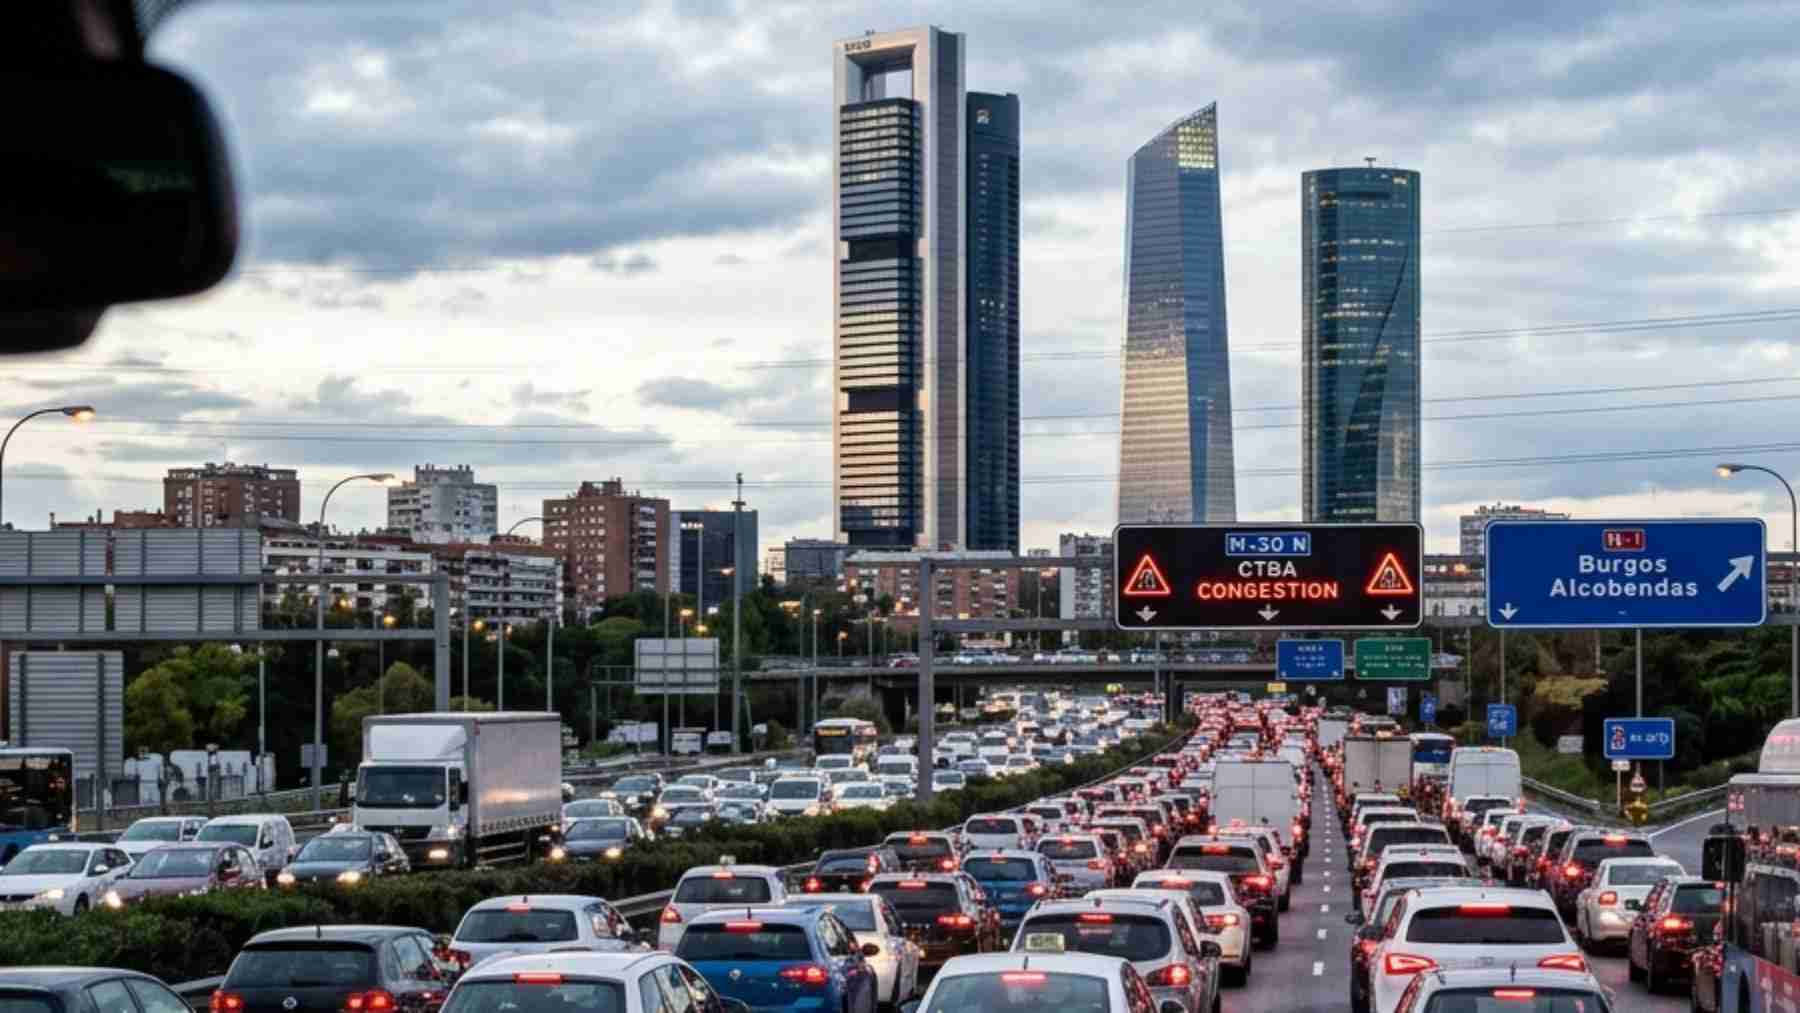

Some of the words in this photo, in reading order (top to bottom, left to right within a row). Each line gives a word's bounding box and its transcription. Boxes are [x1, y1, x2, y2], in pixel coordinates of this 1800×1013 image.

[1293, 536, 1306, 552] N
[1238, 560, 1298, 578] CTBA
[1578, 554, 1668, 577] Burgos
[1197, 582, 1339, 600] CONGESTION
[1549, 577, 1699, 598] Alcobendas
